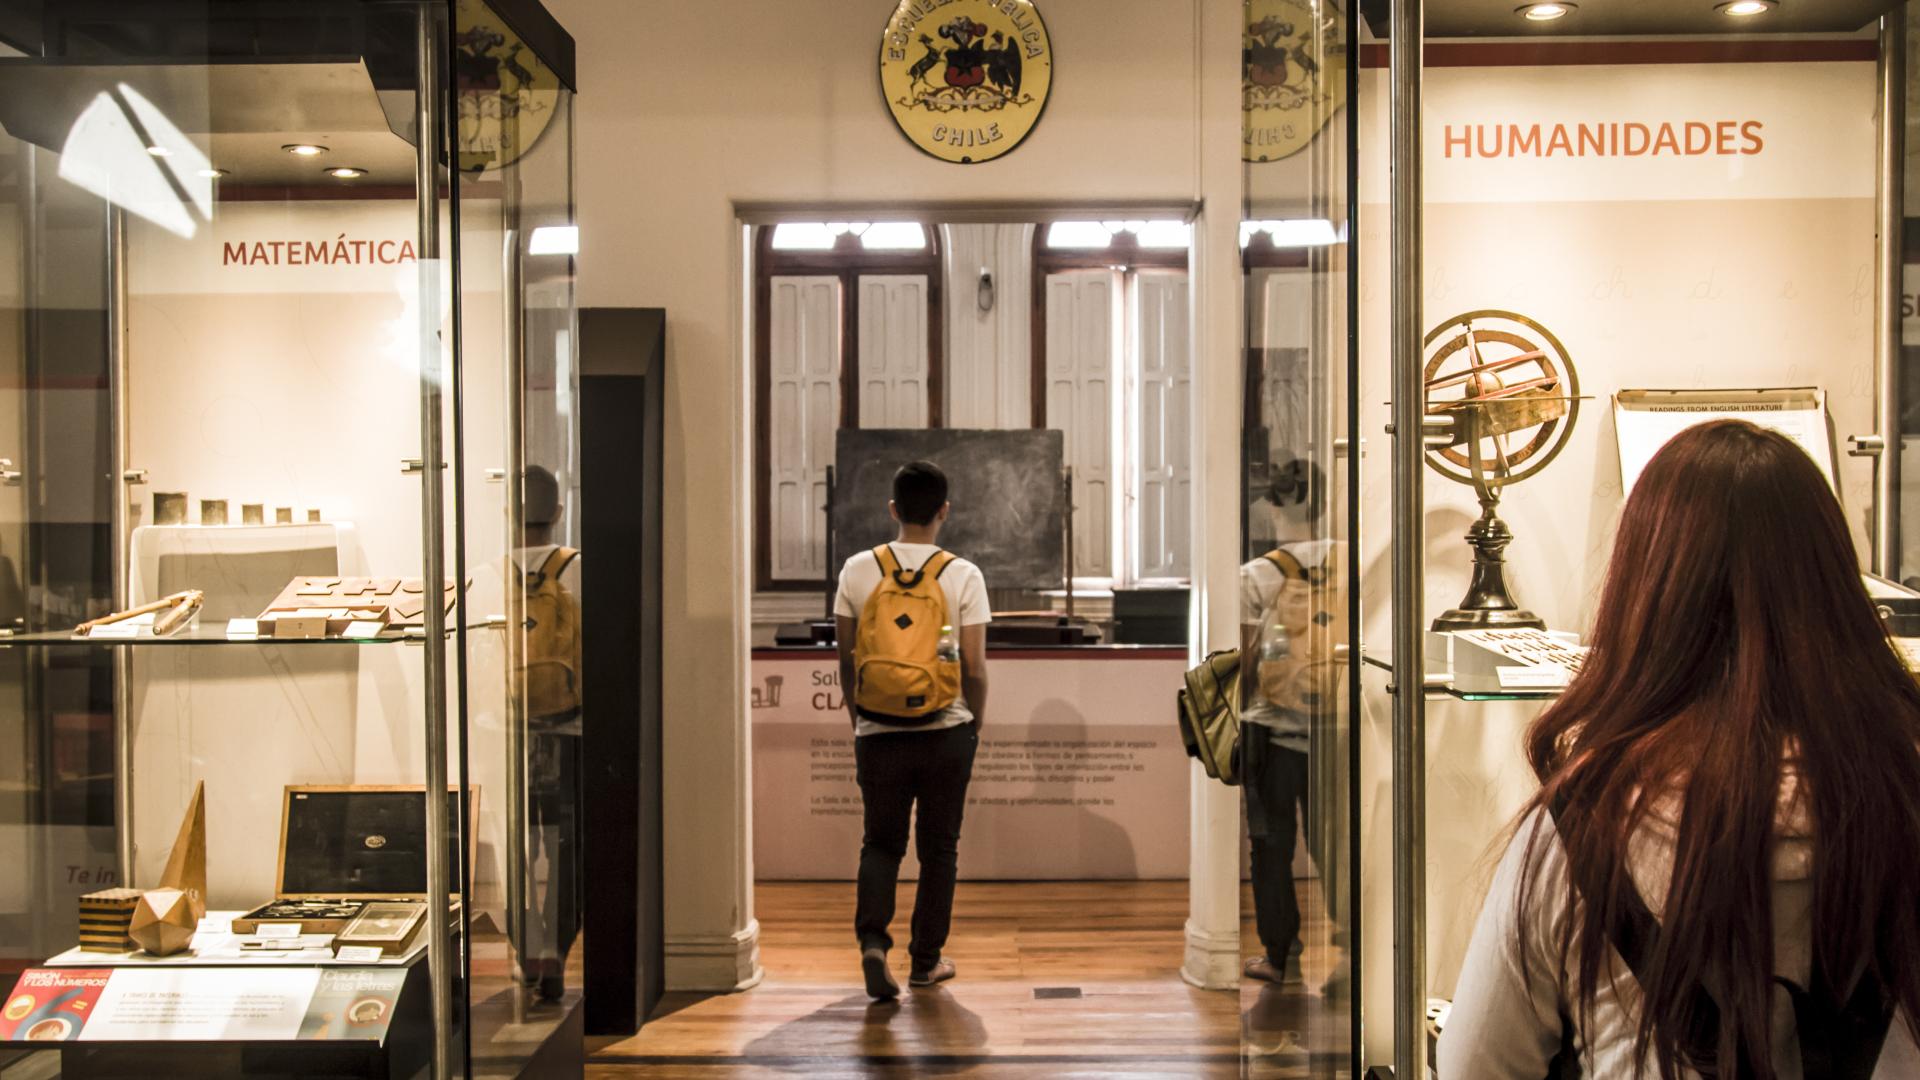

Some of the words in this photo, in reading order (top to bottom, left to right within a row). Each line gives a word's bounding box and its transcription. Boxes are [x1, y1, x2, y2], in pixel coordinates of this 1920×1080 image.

[887, 0, 962, 61] ESCUE
[975, 0, 1044, 59] BLICA
[932, 122, 1004, 147] CHILE
[1444, 121, 1764, 159] HUMANIDADES
[223, 233, 417, 266] MATEMÁTICA
[1901, 293, 1920, 319] S
[811, 670, 839, 687] Sal
[66, 866, 90, 884] Te
[95, 866, 116, 884] in
